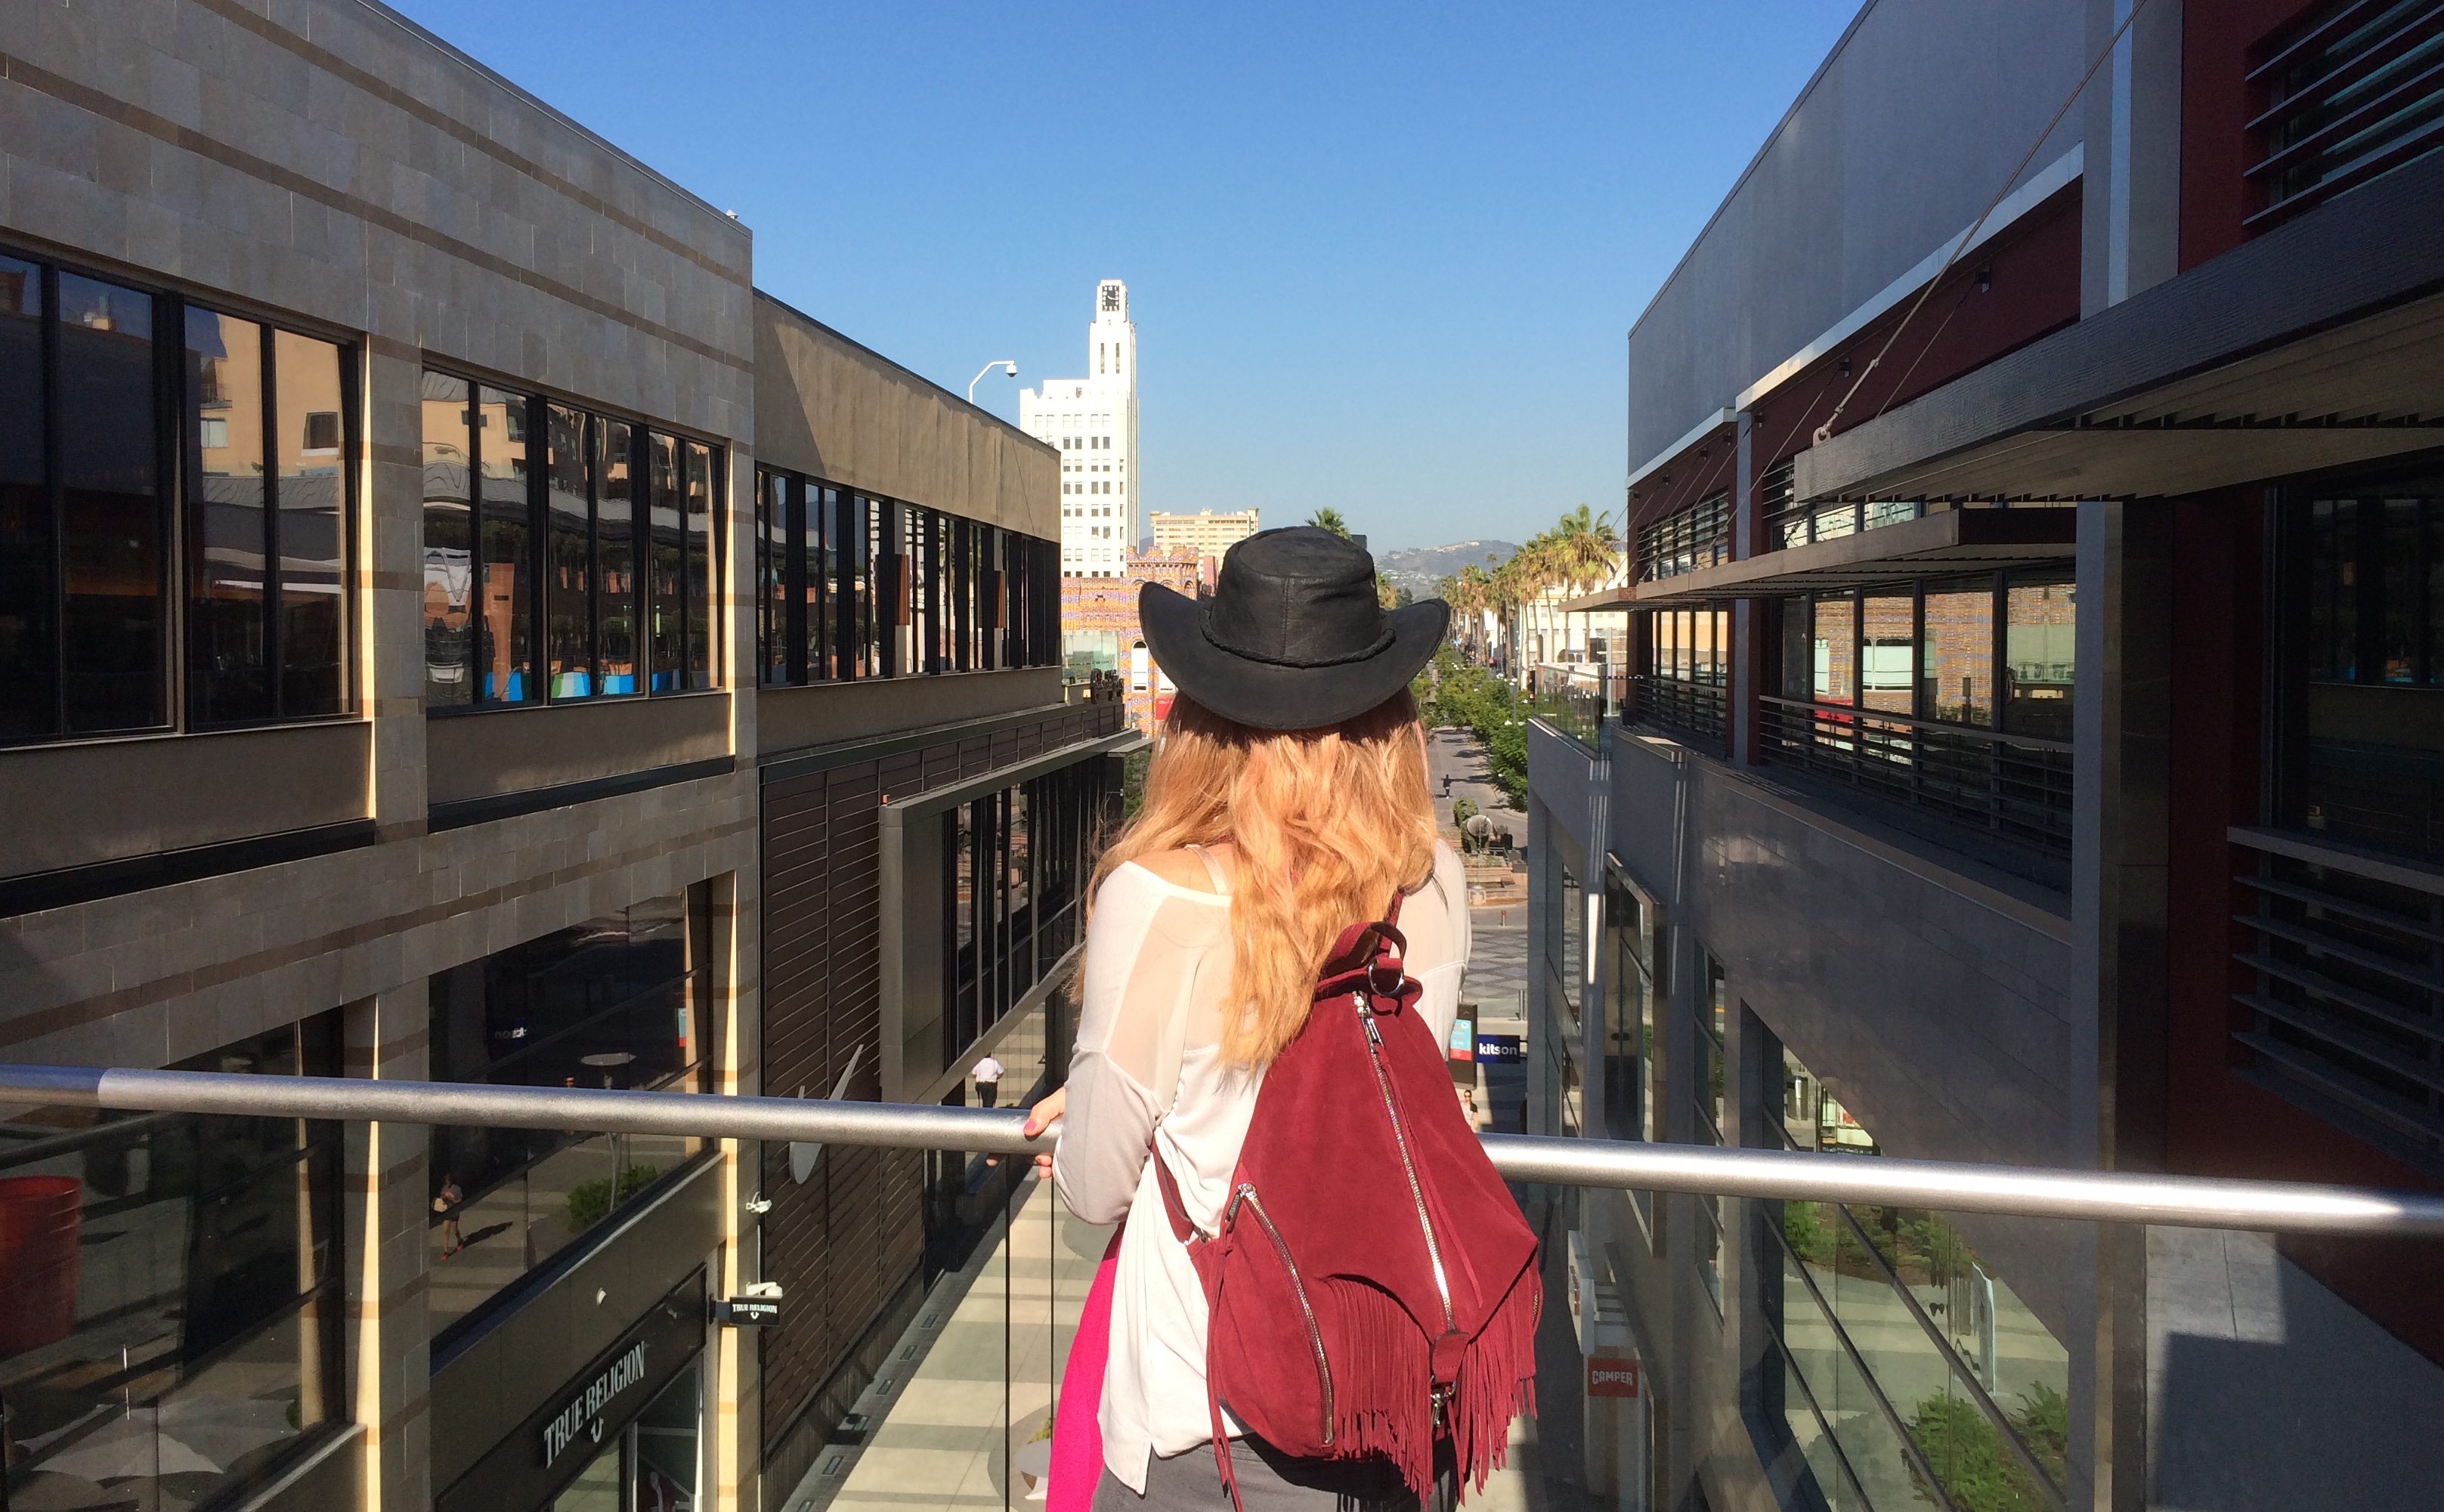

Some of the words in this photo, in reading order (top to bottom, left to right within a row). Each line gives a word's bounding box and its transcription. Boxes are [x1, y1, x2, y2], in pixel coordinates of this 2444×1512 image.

[1479, 1043, 1517, 1055] kitson
[732, 1304, 748, 1313] TRUE
[750, 1304, 778, 1314] RELIGION
[1592, 1370, 1633, 1387] CAMPER
[543, 1395, 583, 1469] TRUE
[586, 1340, 645, 1421] RELIGION
